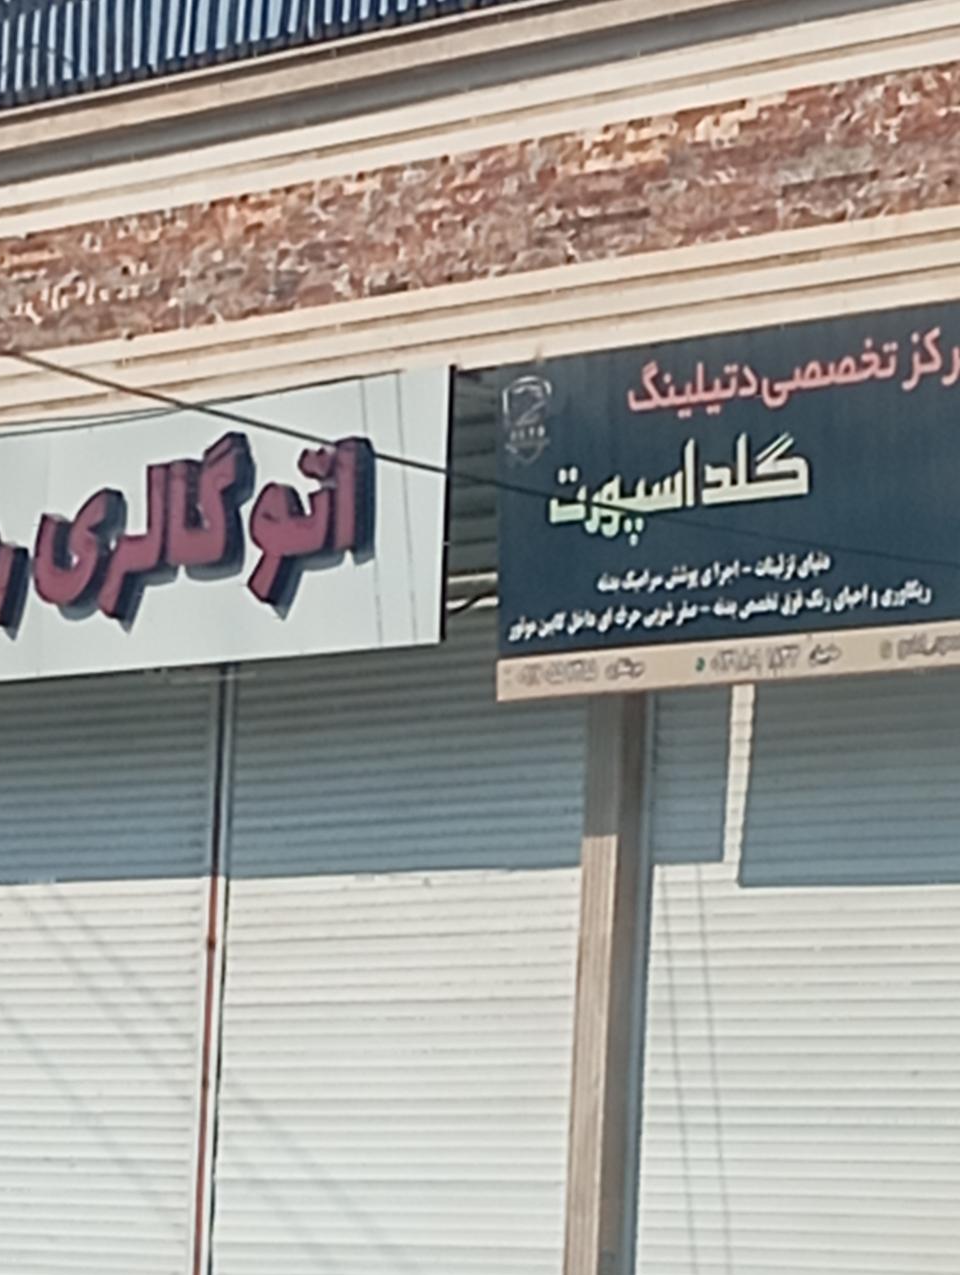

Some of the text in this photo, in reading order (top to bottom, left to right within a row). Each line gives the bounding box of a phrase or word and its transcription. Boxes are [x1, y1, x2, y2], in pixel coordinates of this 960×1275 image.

[627, 327, 960, 418] رکز تخصصی دتیلینگ
[34, 431, 256, 622] گالری
[248, 436, 377, 605] اتو
[549, 432, 809, 547] گلد اسپورت
